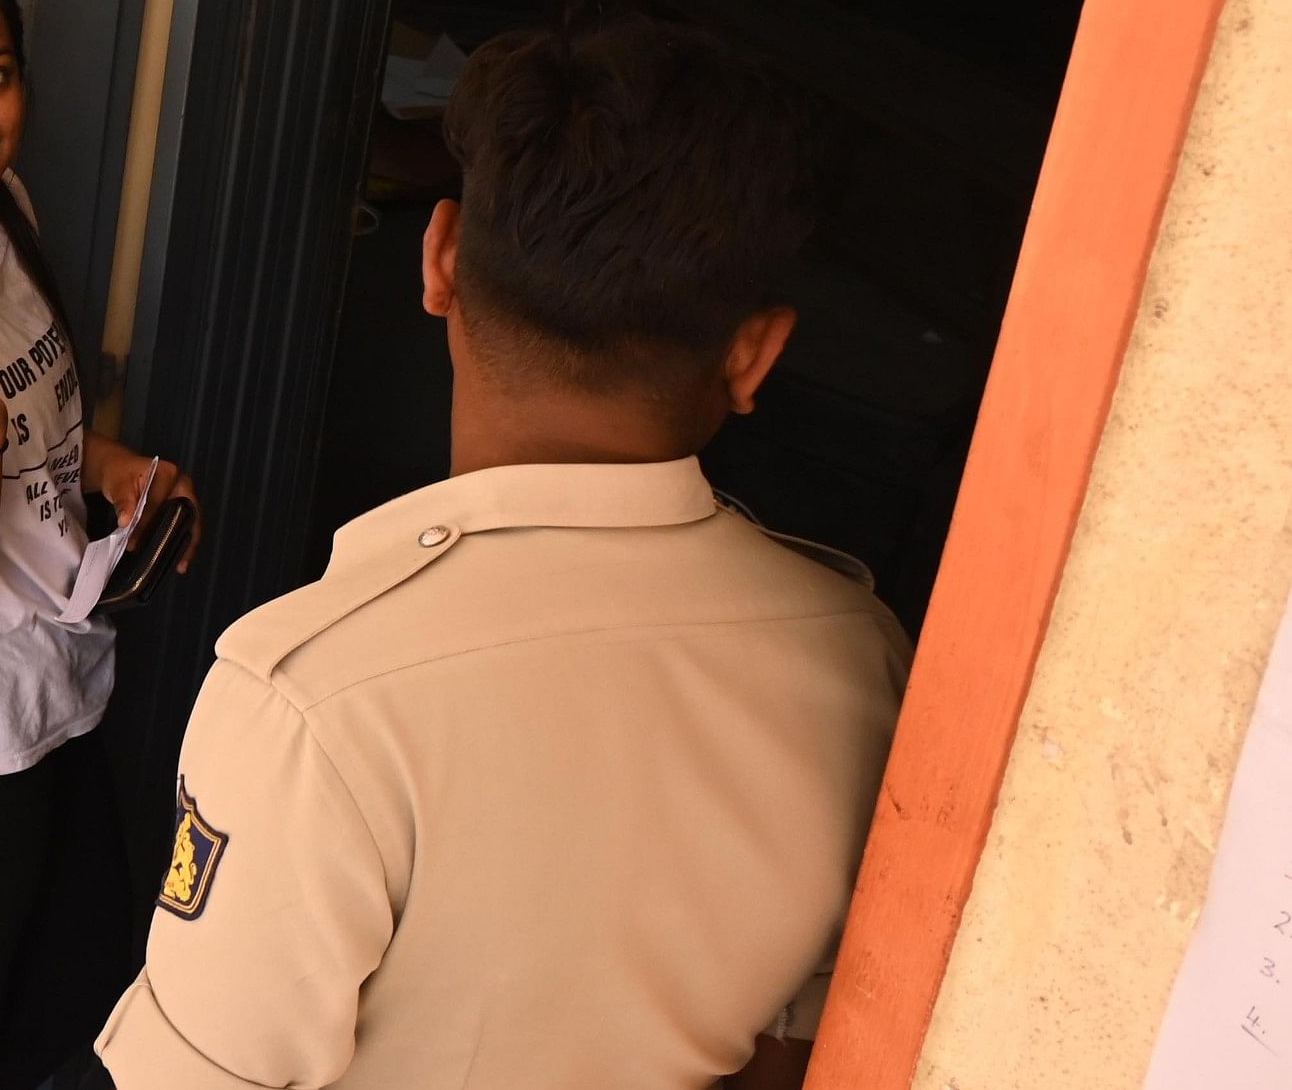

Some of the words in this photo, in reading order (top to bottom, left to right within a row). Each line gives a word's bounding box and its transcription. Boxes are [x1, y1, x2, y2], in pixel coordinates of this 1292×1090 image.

[10, 413, 30, 445] IS
[26, 481, 48, 505] ALL
[40, 500, 52, 521] IS
